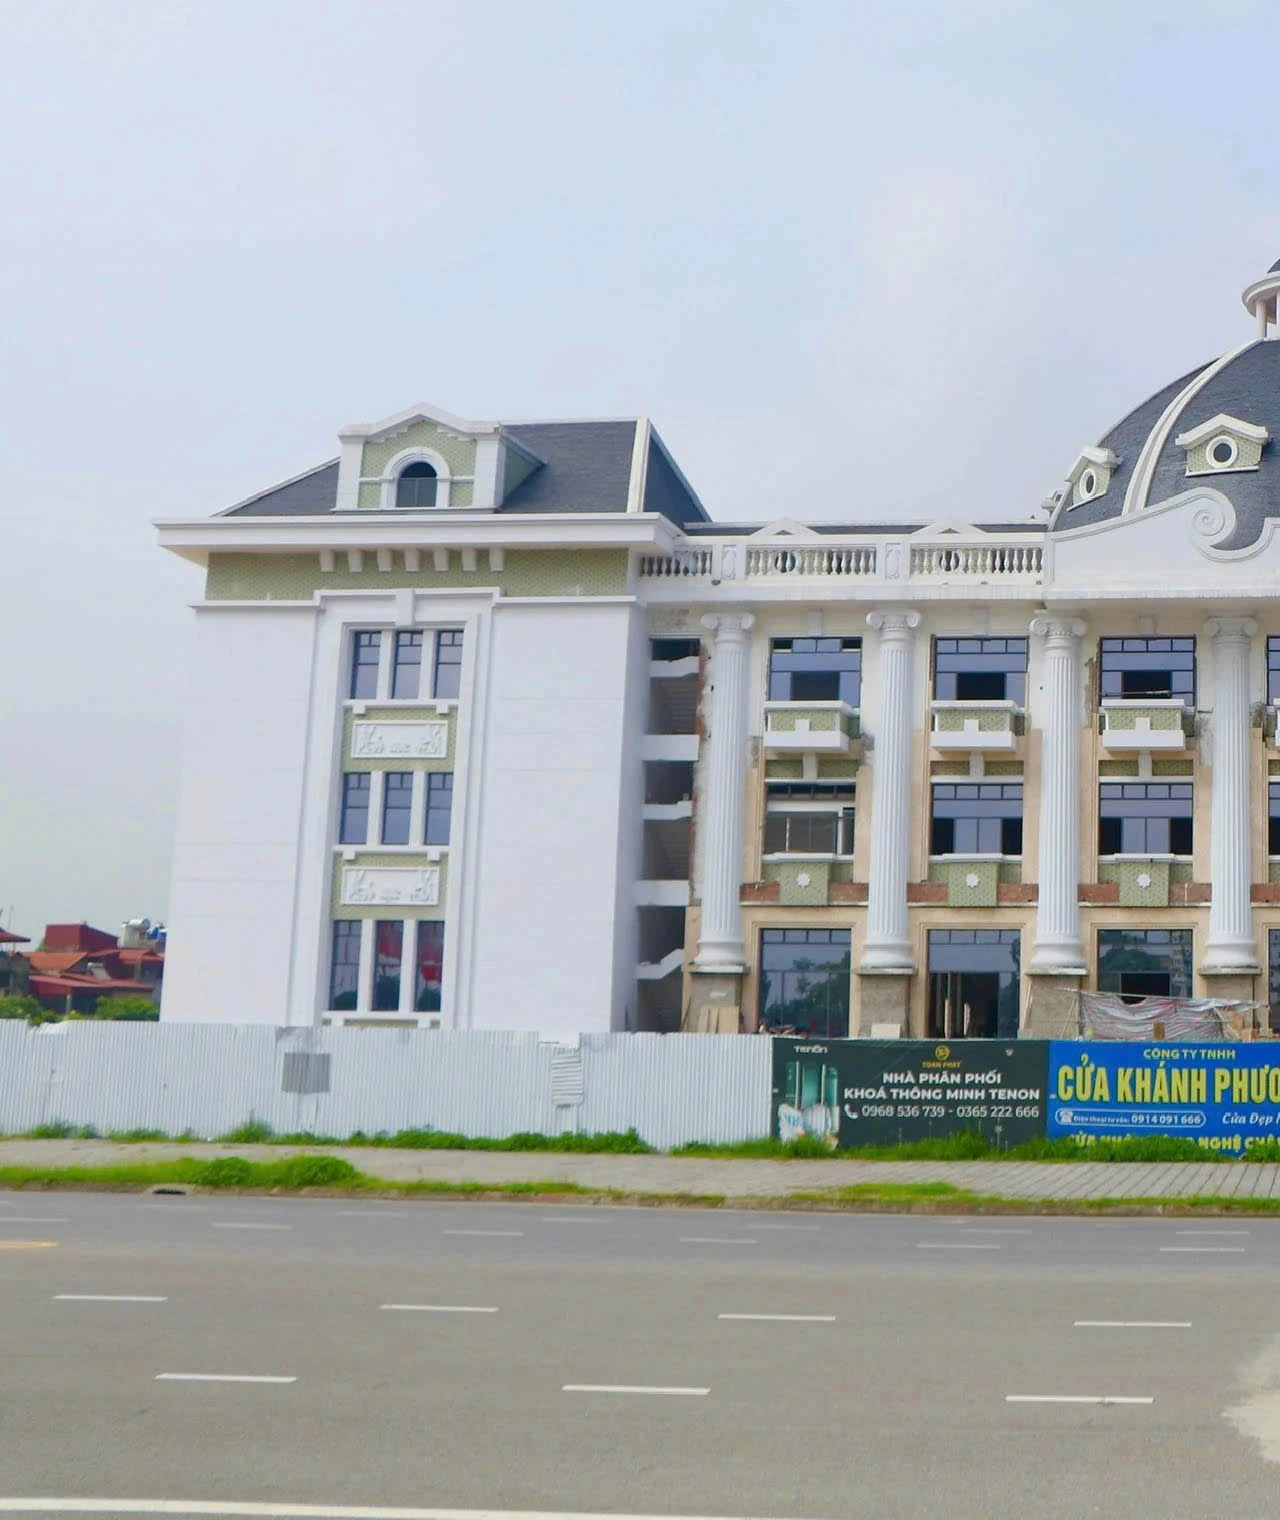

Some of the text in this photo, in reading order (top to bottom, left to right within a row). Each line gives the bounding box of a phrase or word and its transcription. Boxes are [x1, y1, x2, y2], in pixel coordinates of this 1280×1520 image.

[1143, 1048, 1236, 1060] CÔNG TY TNHH
[883, 1069, 1001, 1084] NHÀ PHÂN PHỐI
[1058, 1054, 1109, 1101] CỬA
[1117, 1061, 1206, 1103] KHÁNH
[844, 1085, 1040, 1100] KHOÁ THÔNG MINH TENON
[862, 1105, 894, 1117] 0968
[897, 1105, 919, 1117] 536
[923, 1105, 945, 1117] 739
[957, 1105, 987, 1117] 0365
[991, 1105, 1012, 1117] 222
[1016, 1105, 1039, 1117] 666
[1131, 1114, 1157, 1124] 0914
[1160, 1115, 1179, 1124] 091
[1181, 1115, 1201, 1125] 666
